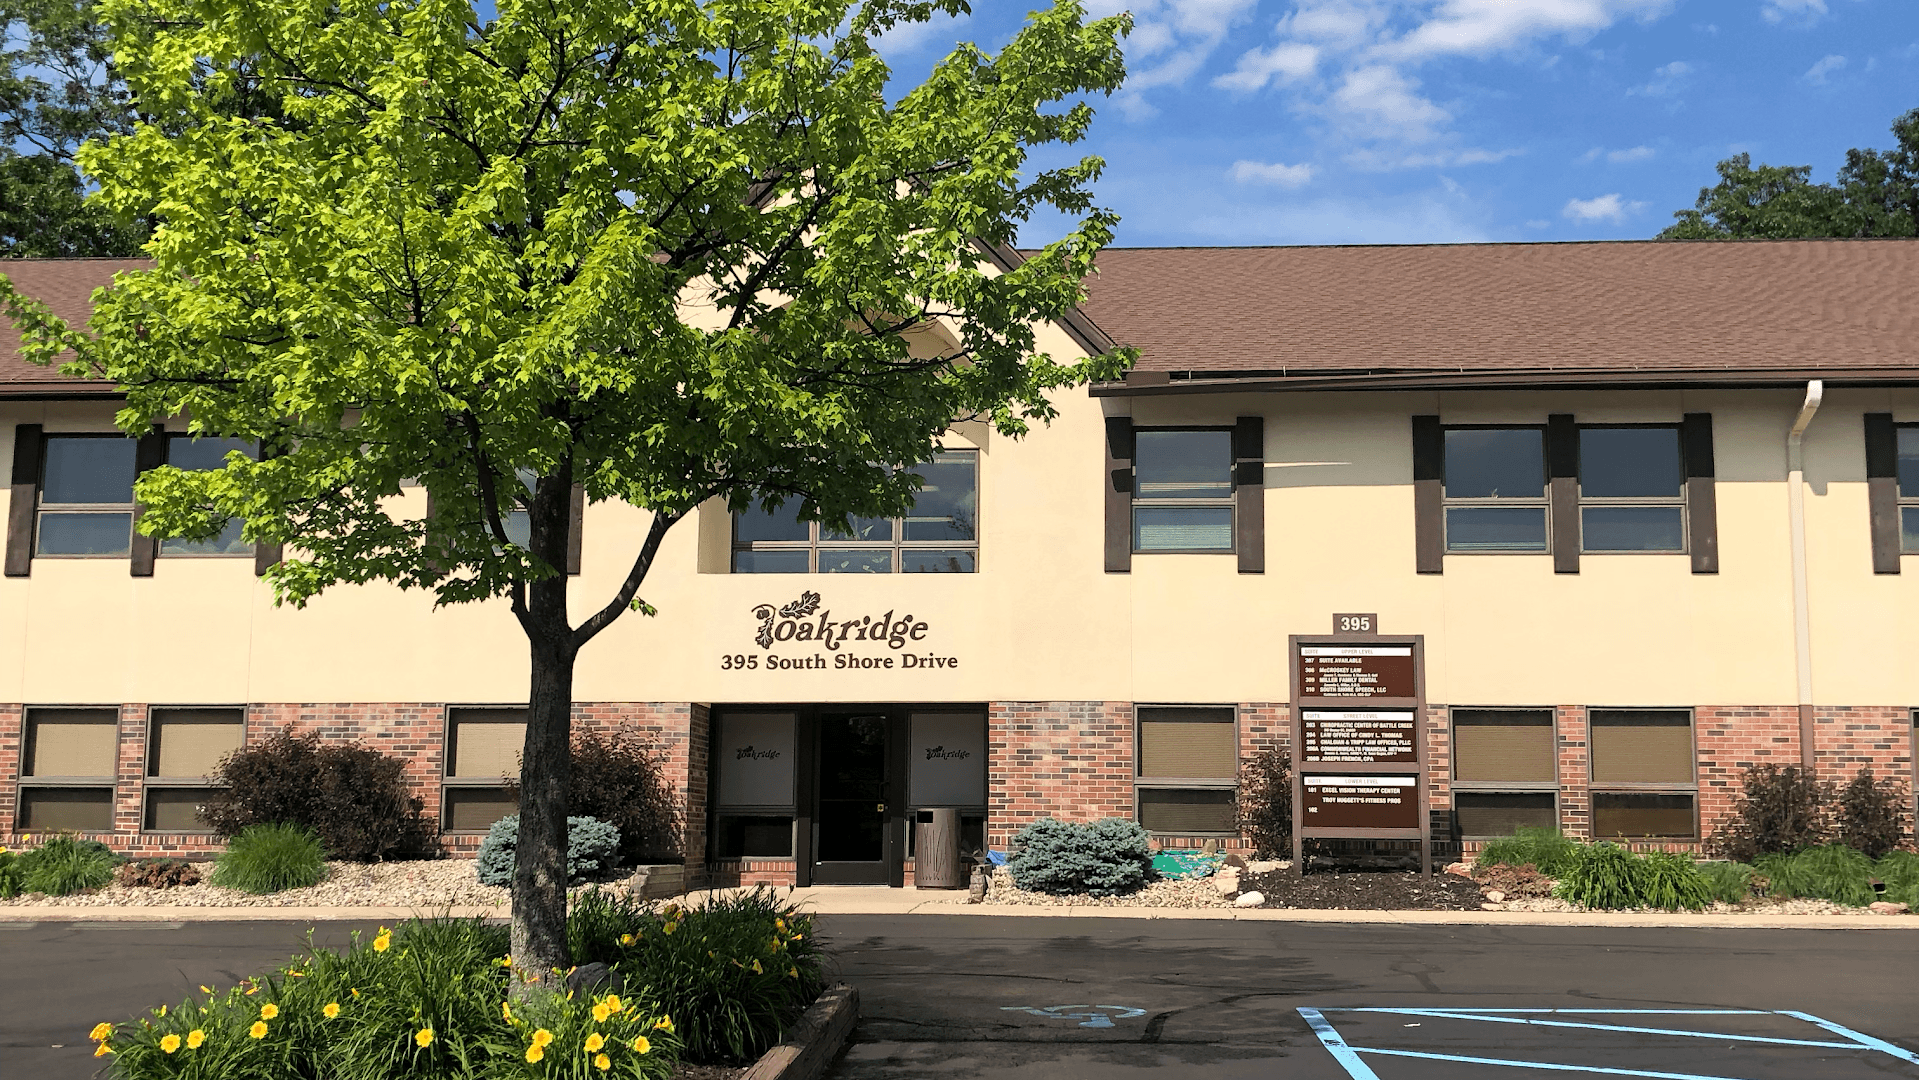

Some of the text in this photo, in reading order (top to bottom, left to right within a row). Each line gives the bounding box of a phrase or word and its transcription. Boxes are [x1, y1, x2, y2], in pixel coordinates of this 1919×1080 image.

[1340, 616, 1370, 631] 395
[721, 652, 958, 670] 395 South Shore Drive
